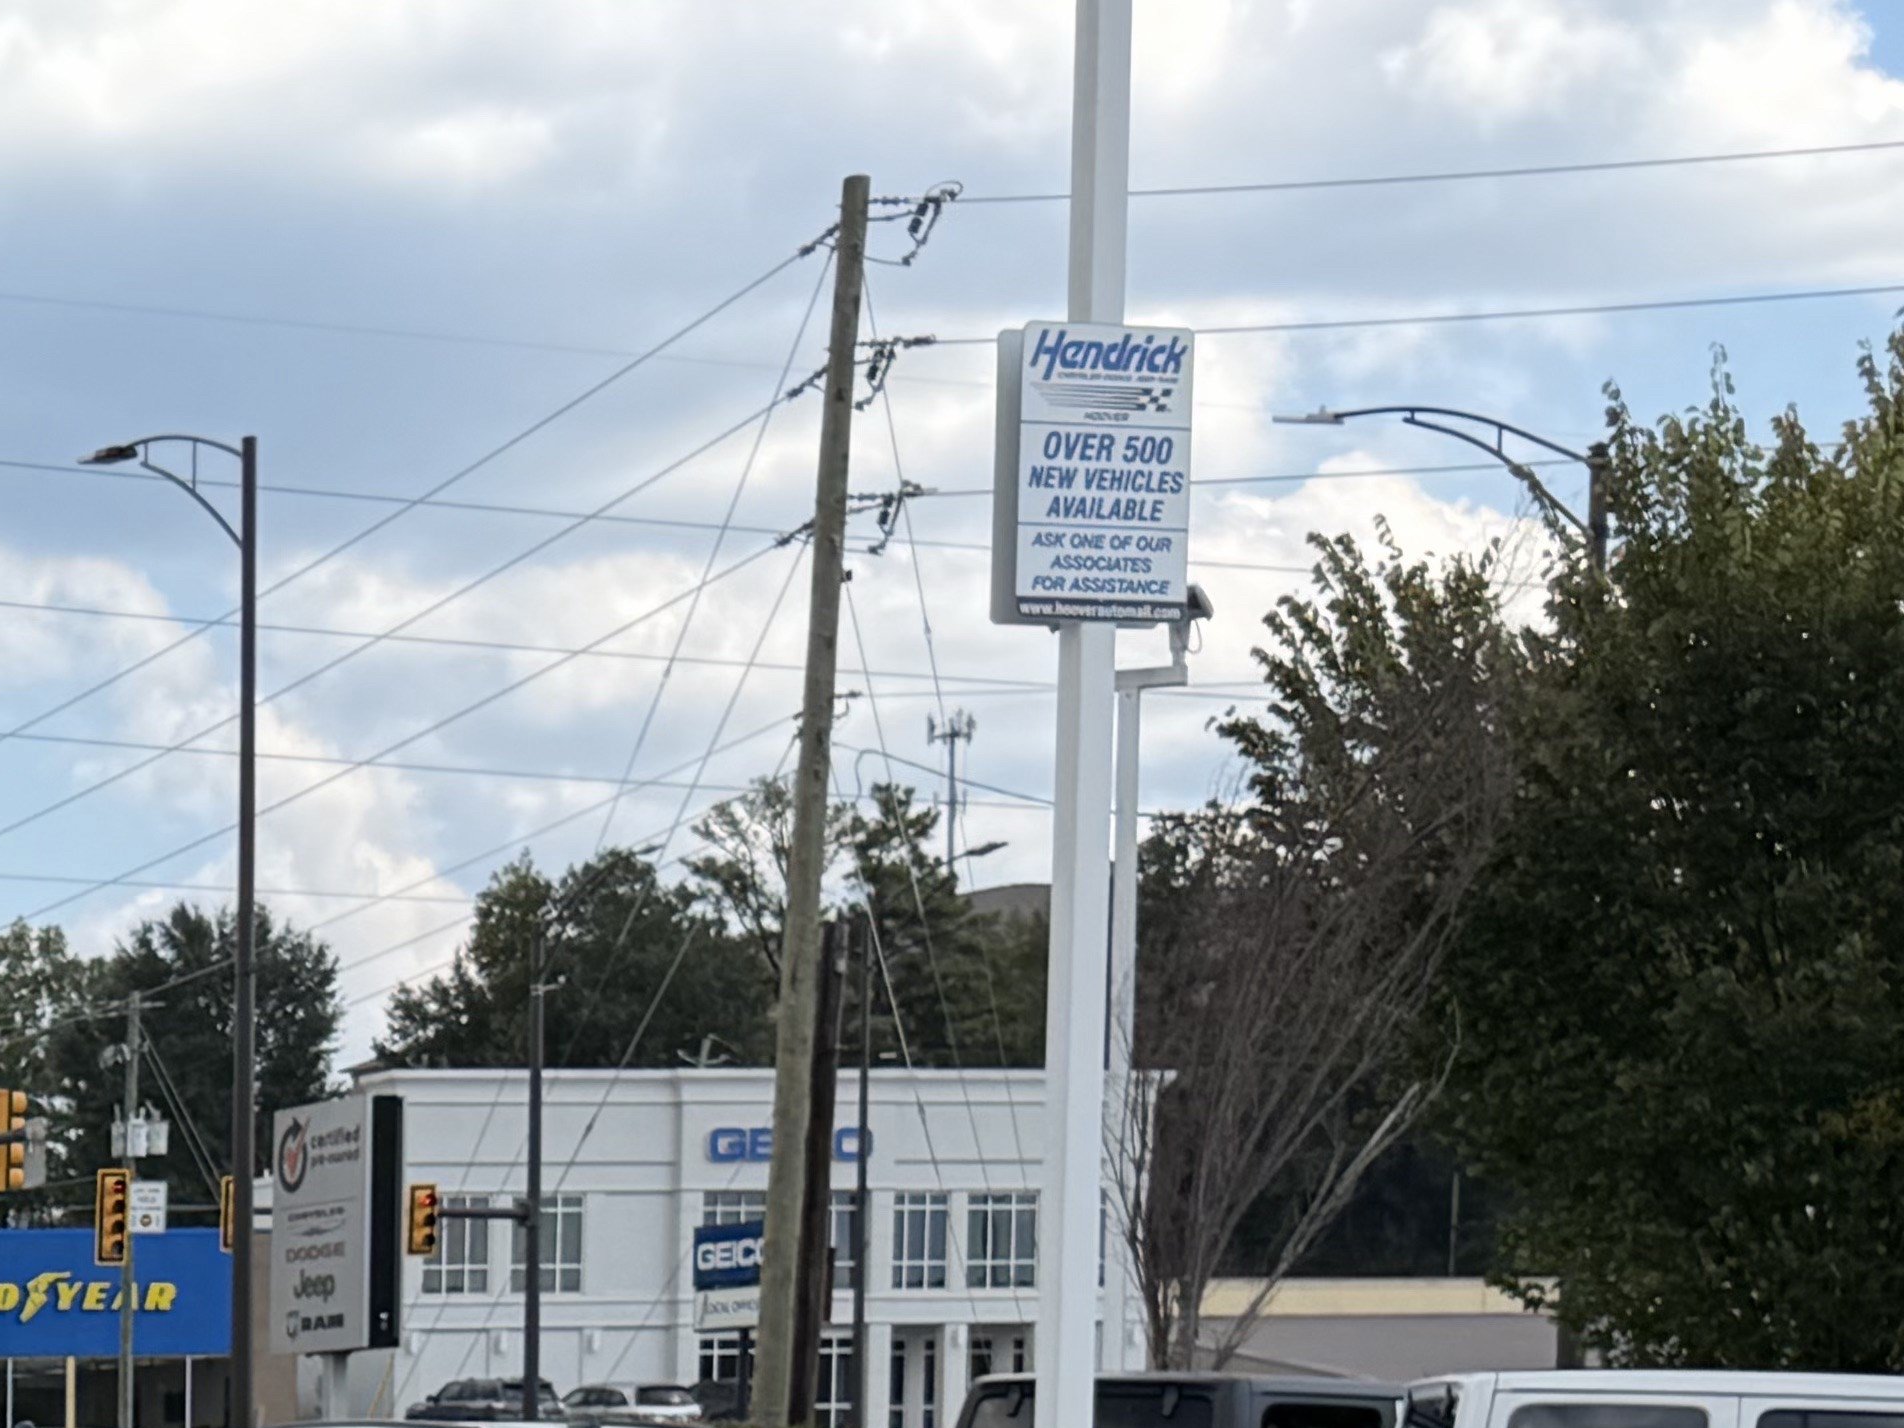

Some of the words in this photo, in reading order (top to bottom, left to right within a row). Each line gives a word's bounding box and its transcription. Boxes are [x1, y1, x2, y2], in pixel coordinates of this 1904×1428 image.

[1029, 328, 1189, 381] Hendrick
[1043, 430, 1116, 462] OVER
[1122, 435, 1174, 465] 500
[1028, 465, 1078, 489] NEW
[1084, 467, 1185, 495] VEHICLES
[1046, 495, 1166, 522] AVAILABLE
[1031, 531, 1067, 548] ASK
[1069, 532, 1107, 550] ONE
[1109, 534, 1133, 551] OF
[1136, 535, 1173, 552] OUR
[1050, 554, 1153, 574] ASSOCIATES
[1031, 574, 1066, 592] FOR
[1068, 576, 1172, 595] ASSISTANCE
[294, 1269, 336, 1303] Jeep
[301, 1313, 345, 1332] RAM
